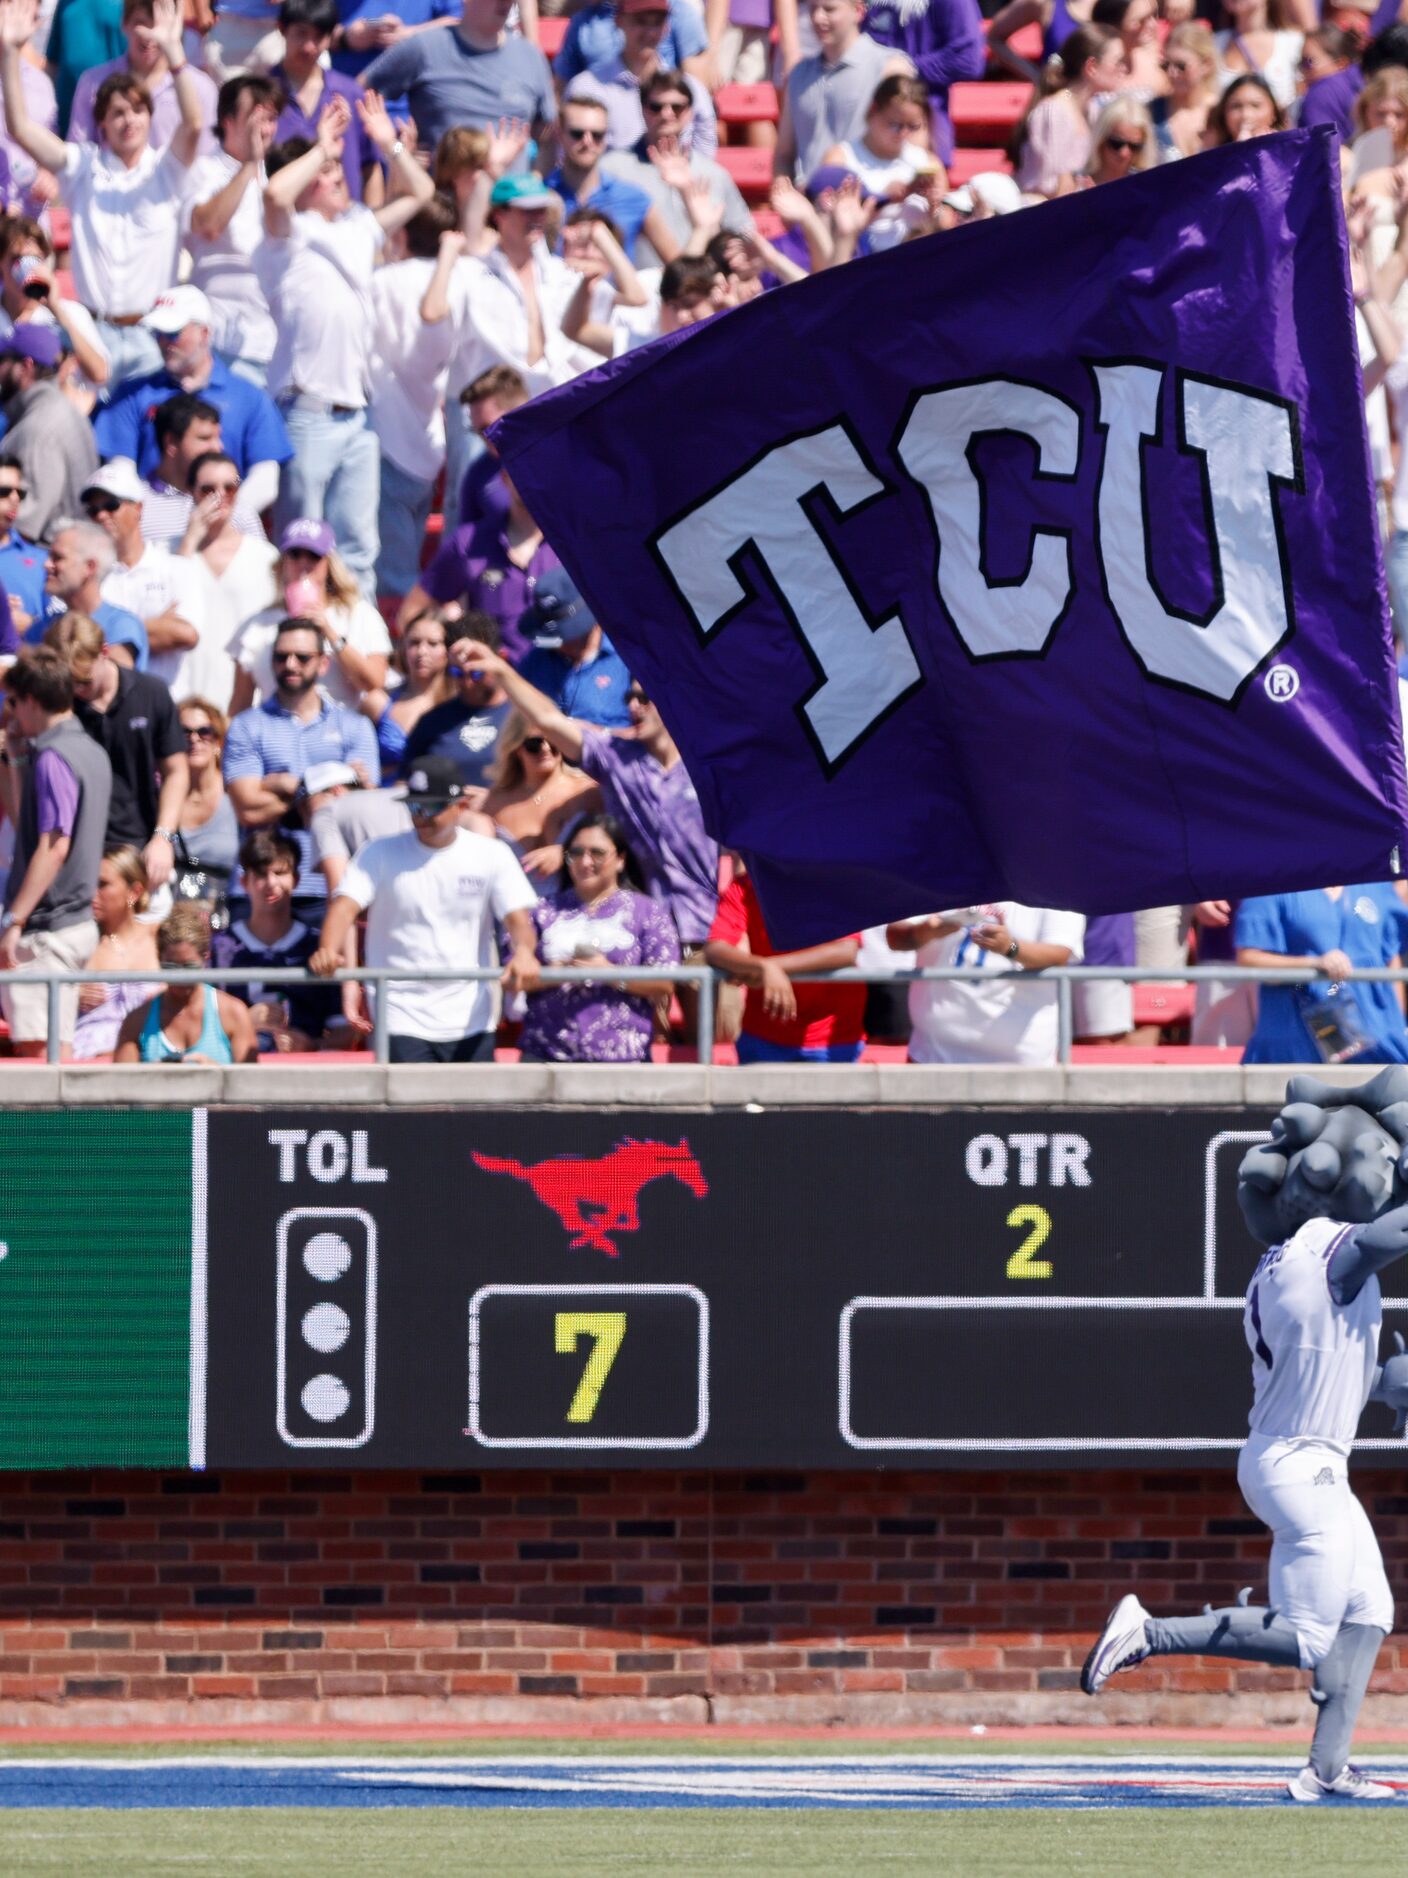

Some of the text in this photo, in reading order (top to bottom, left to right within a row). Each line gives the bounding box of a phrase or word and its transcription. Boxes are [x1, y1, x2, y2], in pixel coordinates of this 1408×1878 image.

[648, 363, 1301, 777] TCU
[268, 1130, 388, 1183] TOL
[965, 1134, 1092, 1187] QTR
[1006, 1204, 1053, 1279] 2
[555, 1312, 627, 1423] 7
